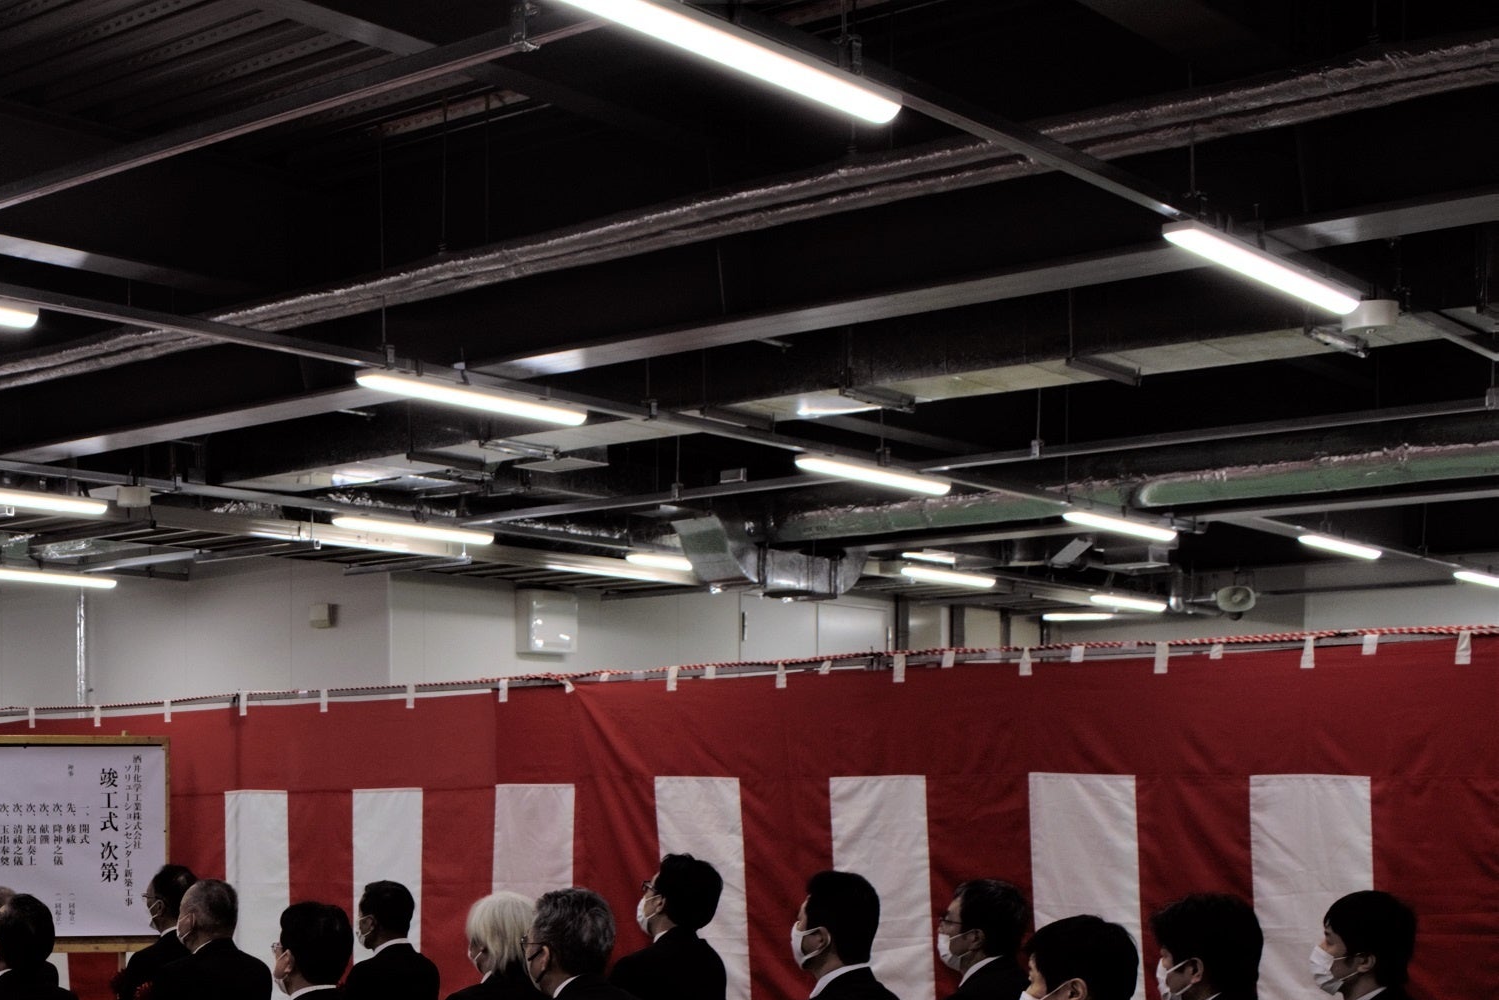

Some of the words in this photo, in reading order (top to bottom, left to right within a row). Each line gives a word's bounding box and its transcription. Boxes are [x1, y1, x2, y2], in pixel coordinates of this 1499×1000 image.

[124, 764, 133, 906] ソリューションセンター新築工事
[133, 754, 142, 849] 酒井化学工業株式会社
